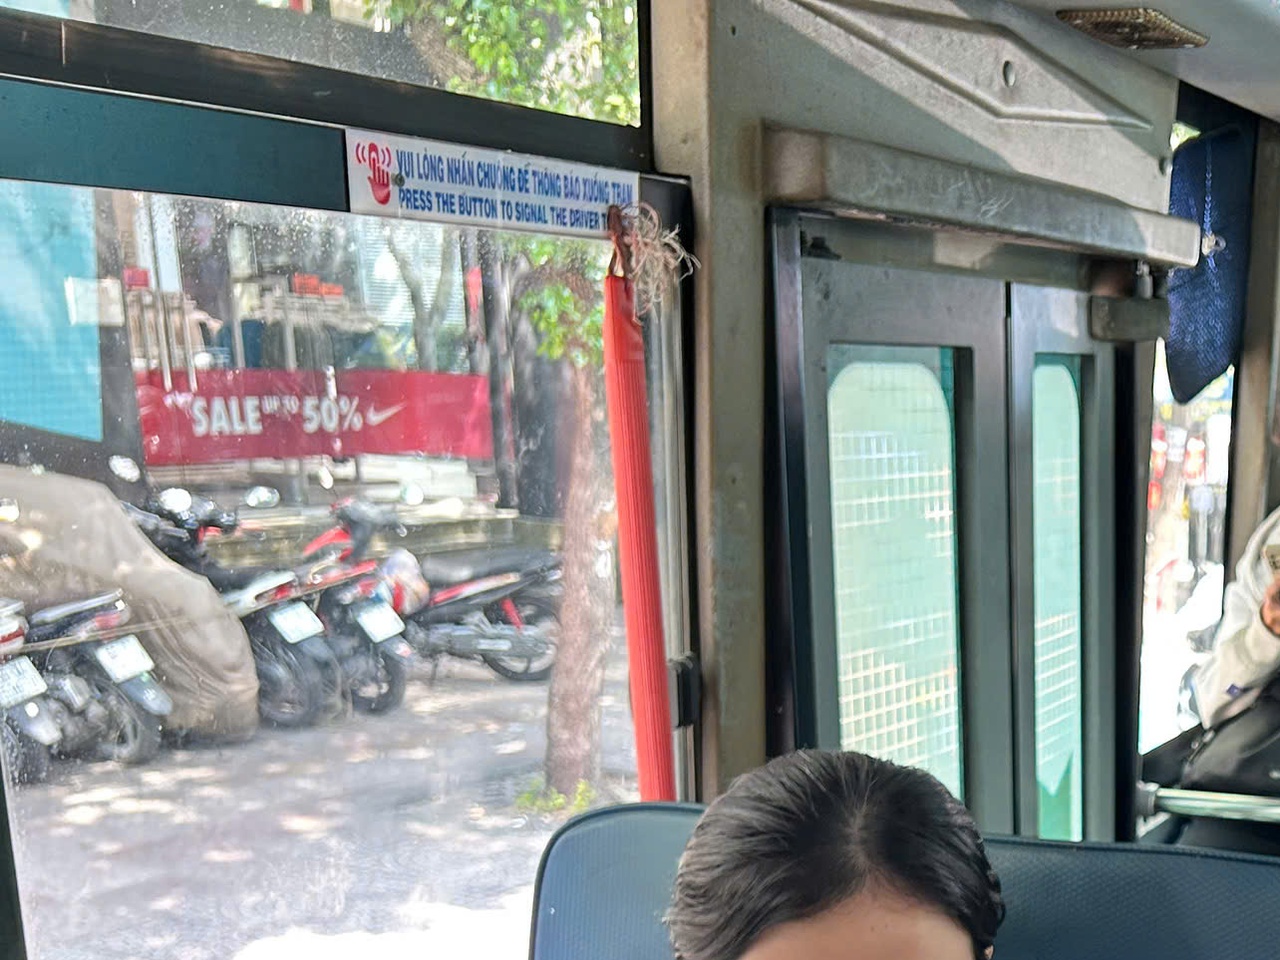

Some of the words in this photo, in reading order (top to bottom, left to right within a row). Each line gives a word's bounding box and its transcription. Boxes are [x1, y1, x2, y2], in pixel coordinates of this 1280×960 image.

[396, 149, 414, 178] VUI
[398, 187, 432, 211] PRESS
[435, 191, 455, 214] THE
[458, 194, 497, 219] BUTTON
[501, 200, 513, 220] TO
[515, 201, 547, 224] SIGNAL
[550, 206, 567, 227] THE
[569, 208, 600, 230] DRIVER
[192, 395, 263, 437] SALE
[263, 395, 280, 414] UP
[282, 395, 299, 414] TO
[302, 394, 364, 433] 50%
